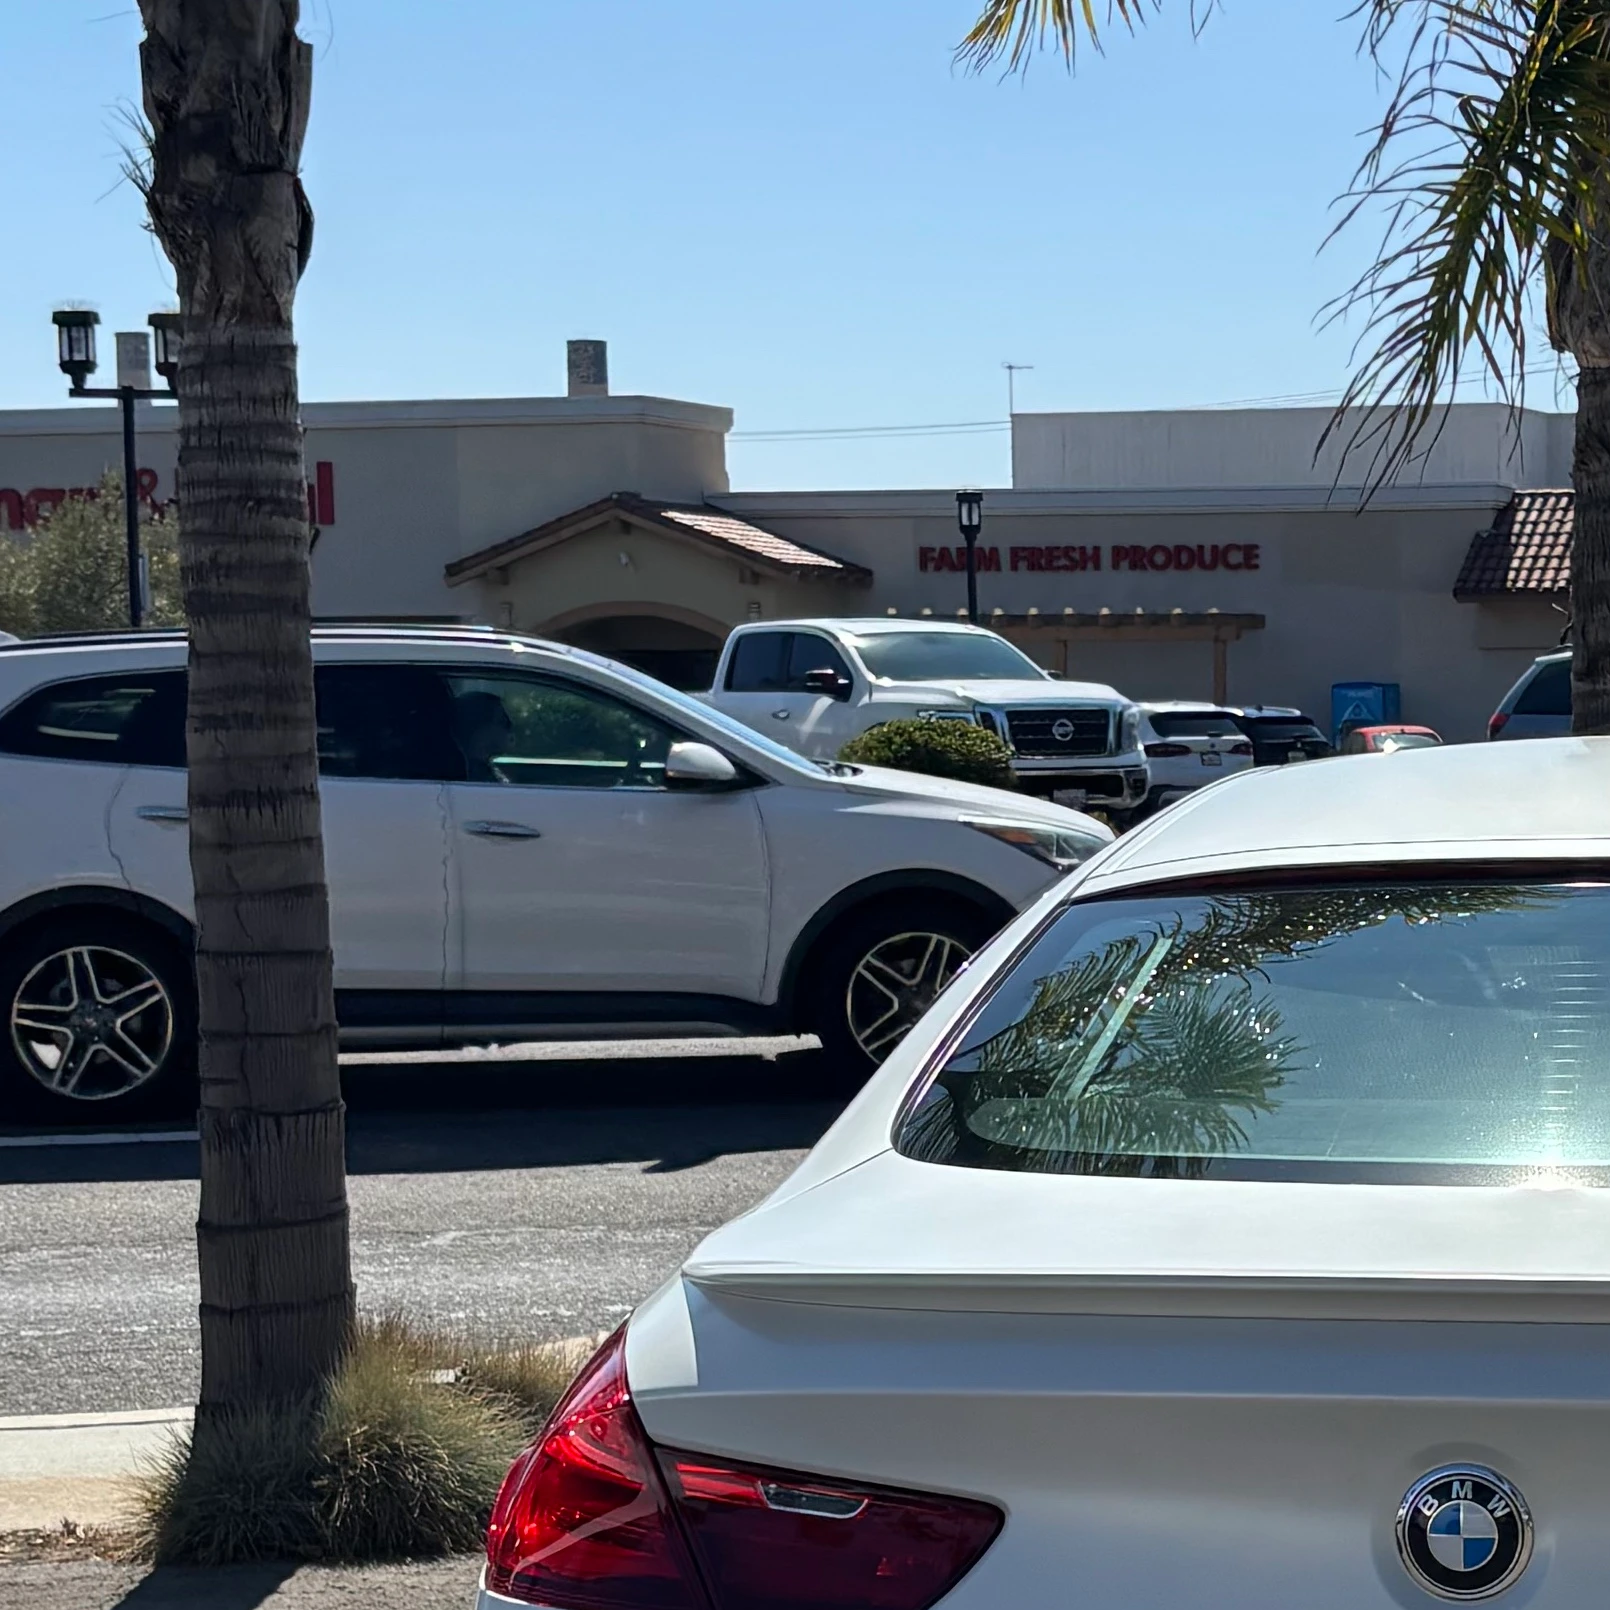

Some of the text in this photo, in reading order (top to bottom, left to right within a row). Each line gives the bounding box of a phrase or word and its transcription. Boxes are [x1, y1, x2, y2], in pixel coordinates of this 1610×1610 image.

[1009, 546, 1101, 572] FRESH
[1111, 543, 1261, 571] PRODUCE
[1418, 1481, 1511, 1518] BMW
